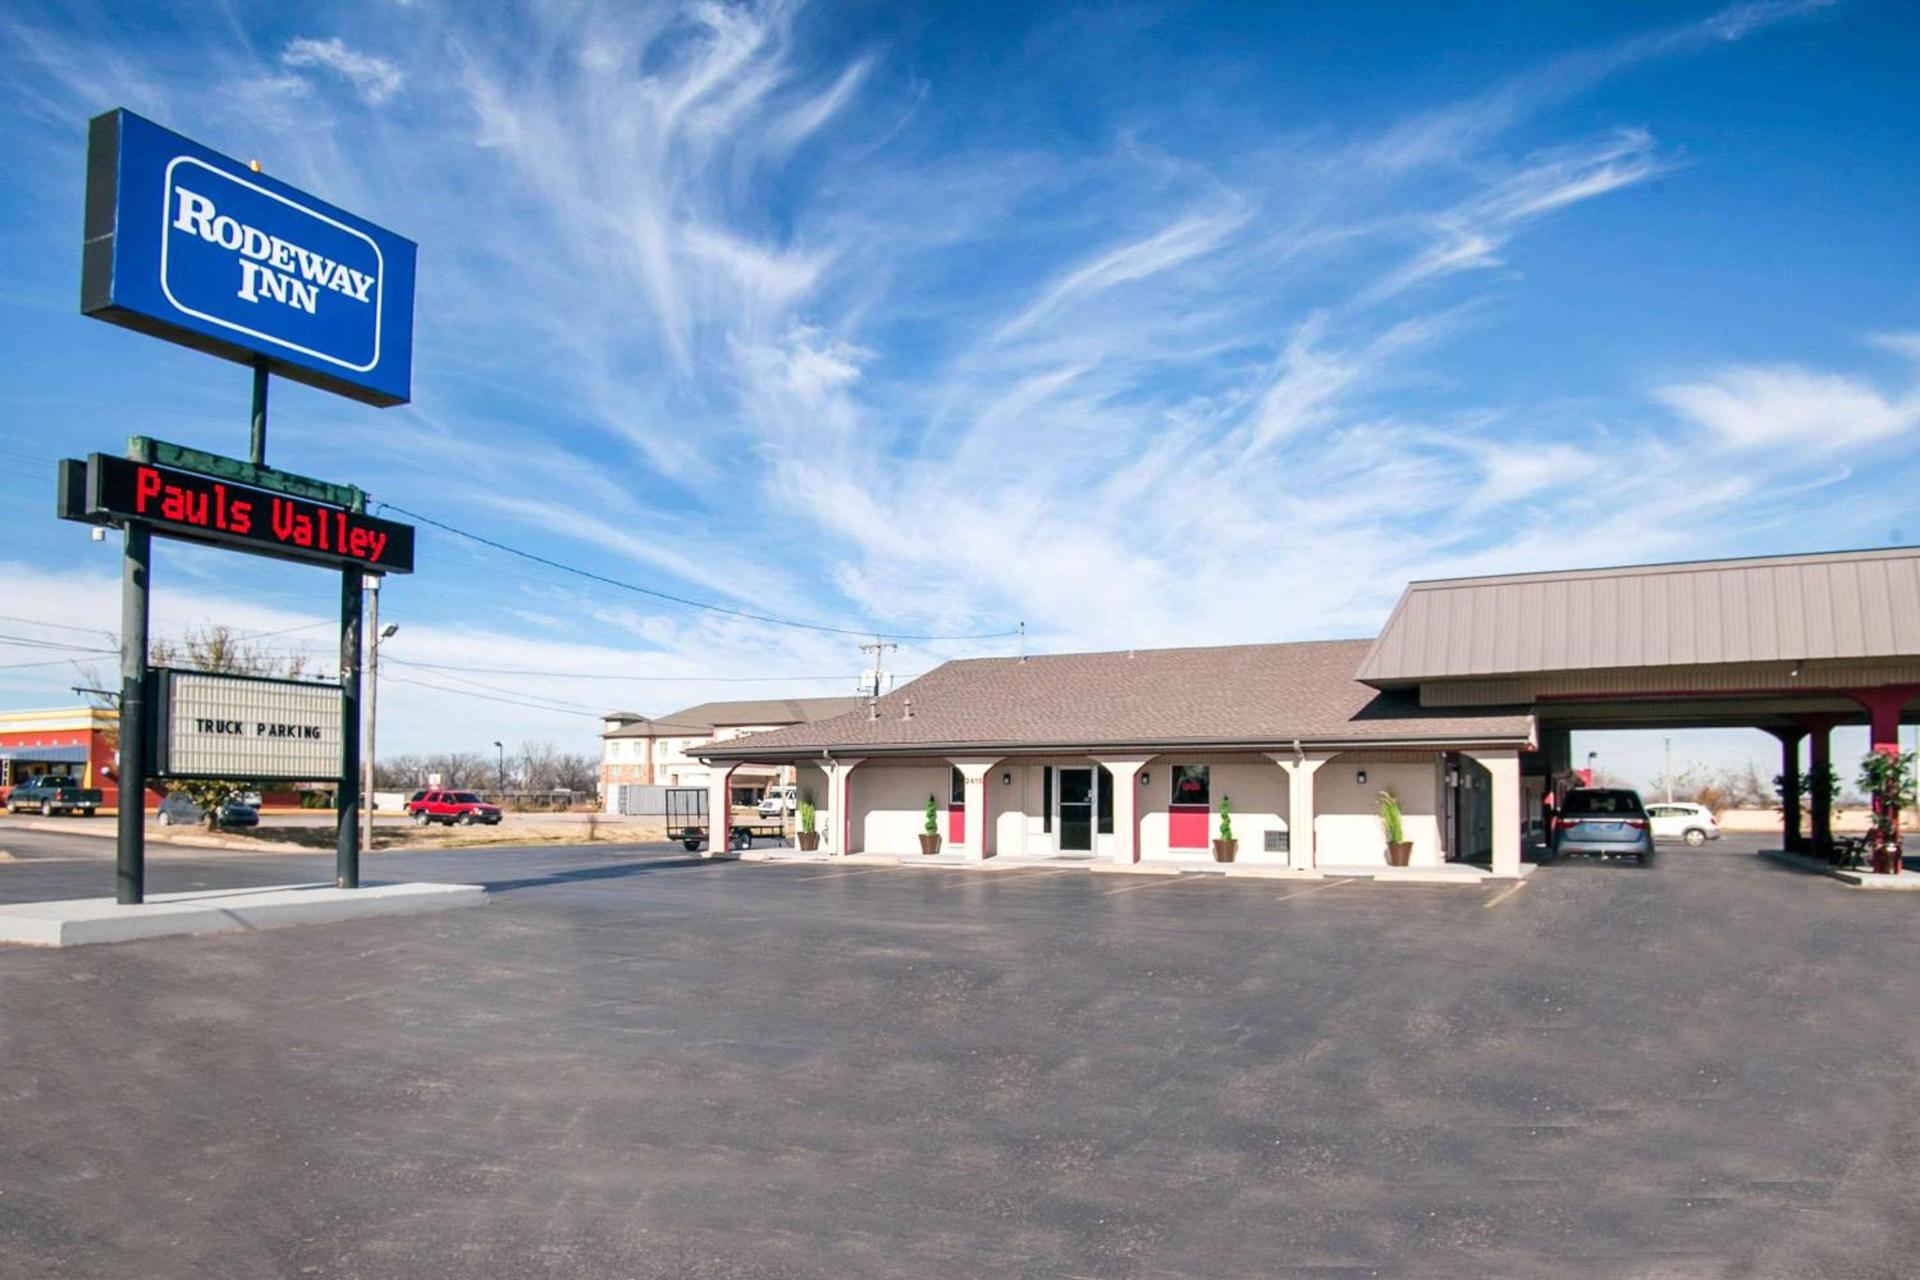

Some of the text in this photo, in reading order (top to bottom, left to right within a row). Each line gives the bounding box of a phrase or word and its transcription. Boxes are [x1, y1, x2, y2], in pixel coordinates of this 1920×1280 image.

[173, 186, 375, 303] RODEWAY
[237, 258, 319, 315] INN
[136, 466, 387, 563] Pauls Valley
[196, 718, 321, 739] TRUCK PARKING
